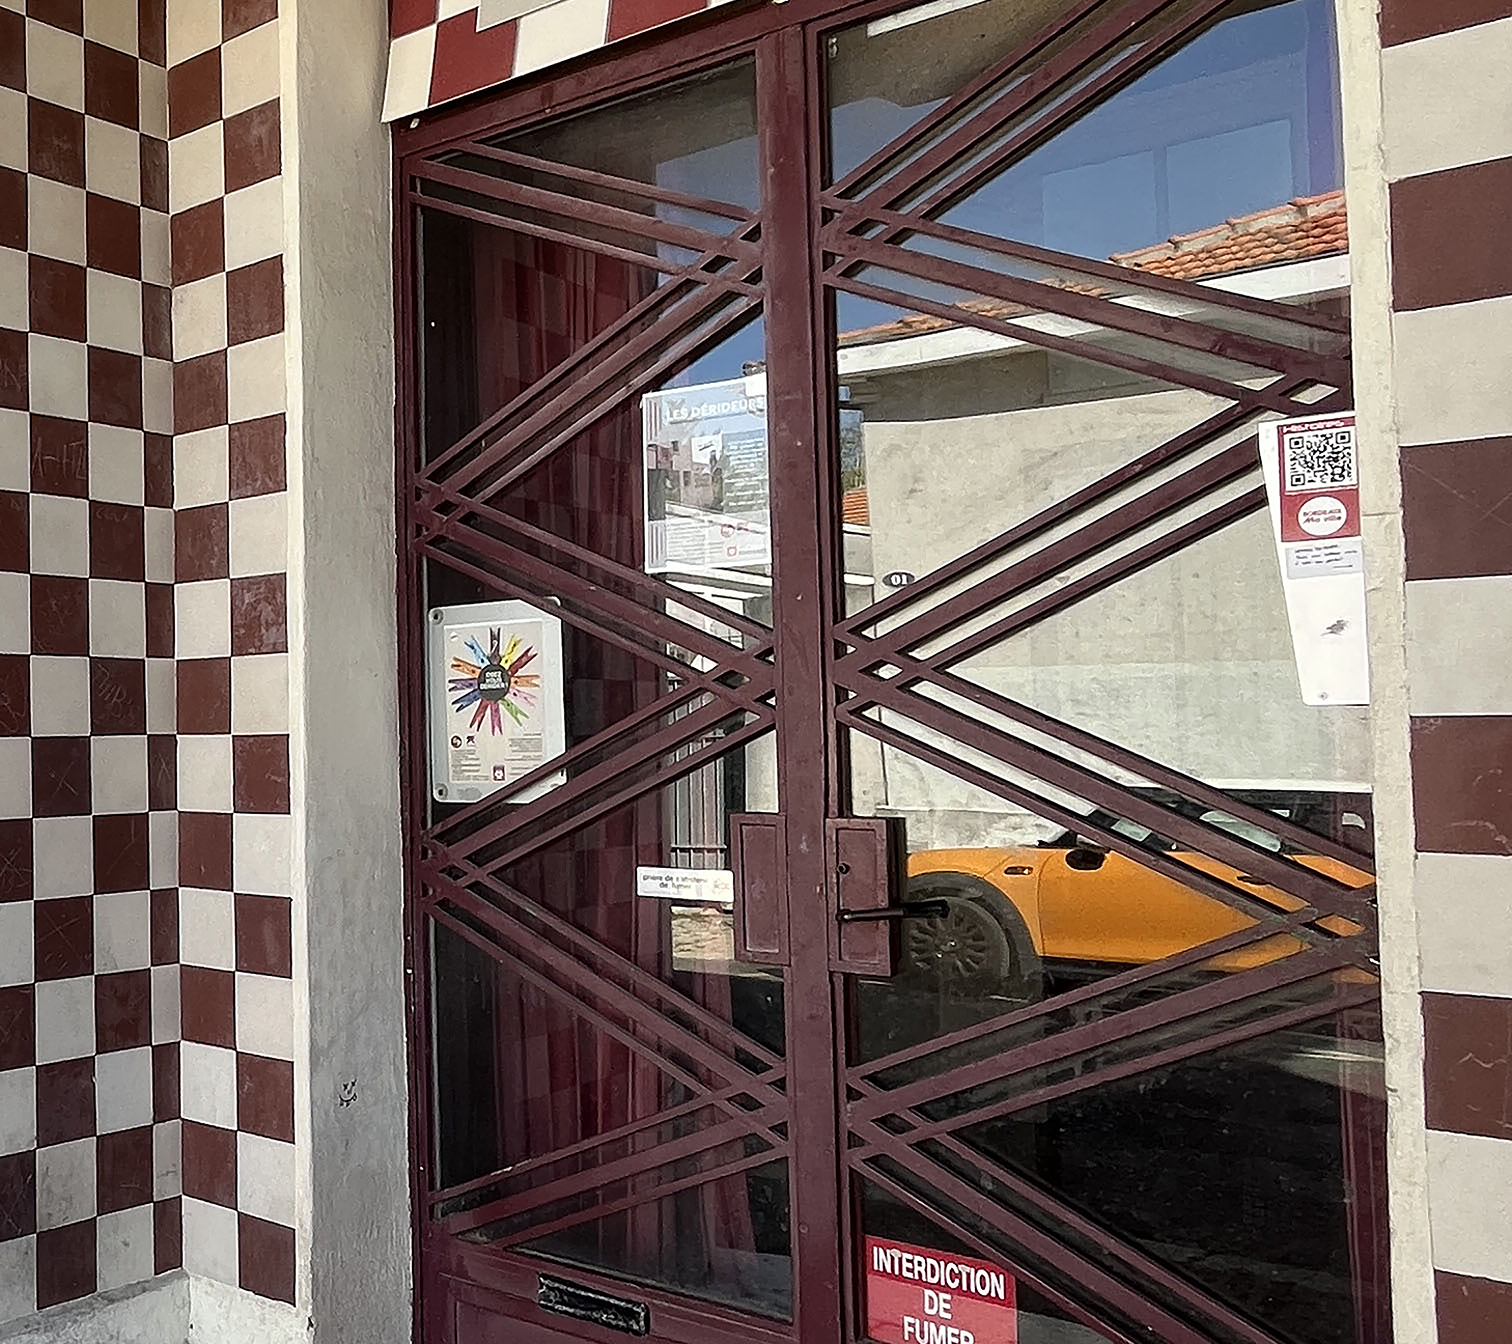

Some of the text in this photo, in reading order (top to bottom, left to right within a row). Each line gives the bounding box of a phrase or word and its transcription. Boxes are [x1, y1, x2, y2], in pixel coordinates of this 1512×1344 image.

[667, 405, 688, 421] LES
[872, 1245, 1006, 1301] INTERDICTION
[922, 1287, 953, 1321] DE
